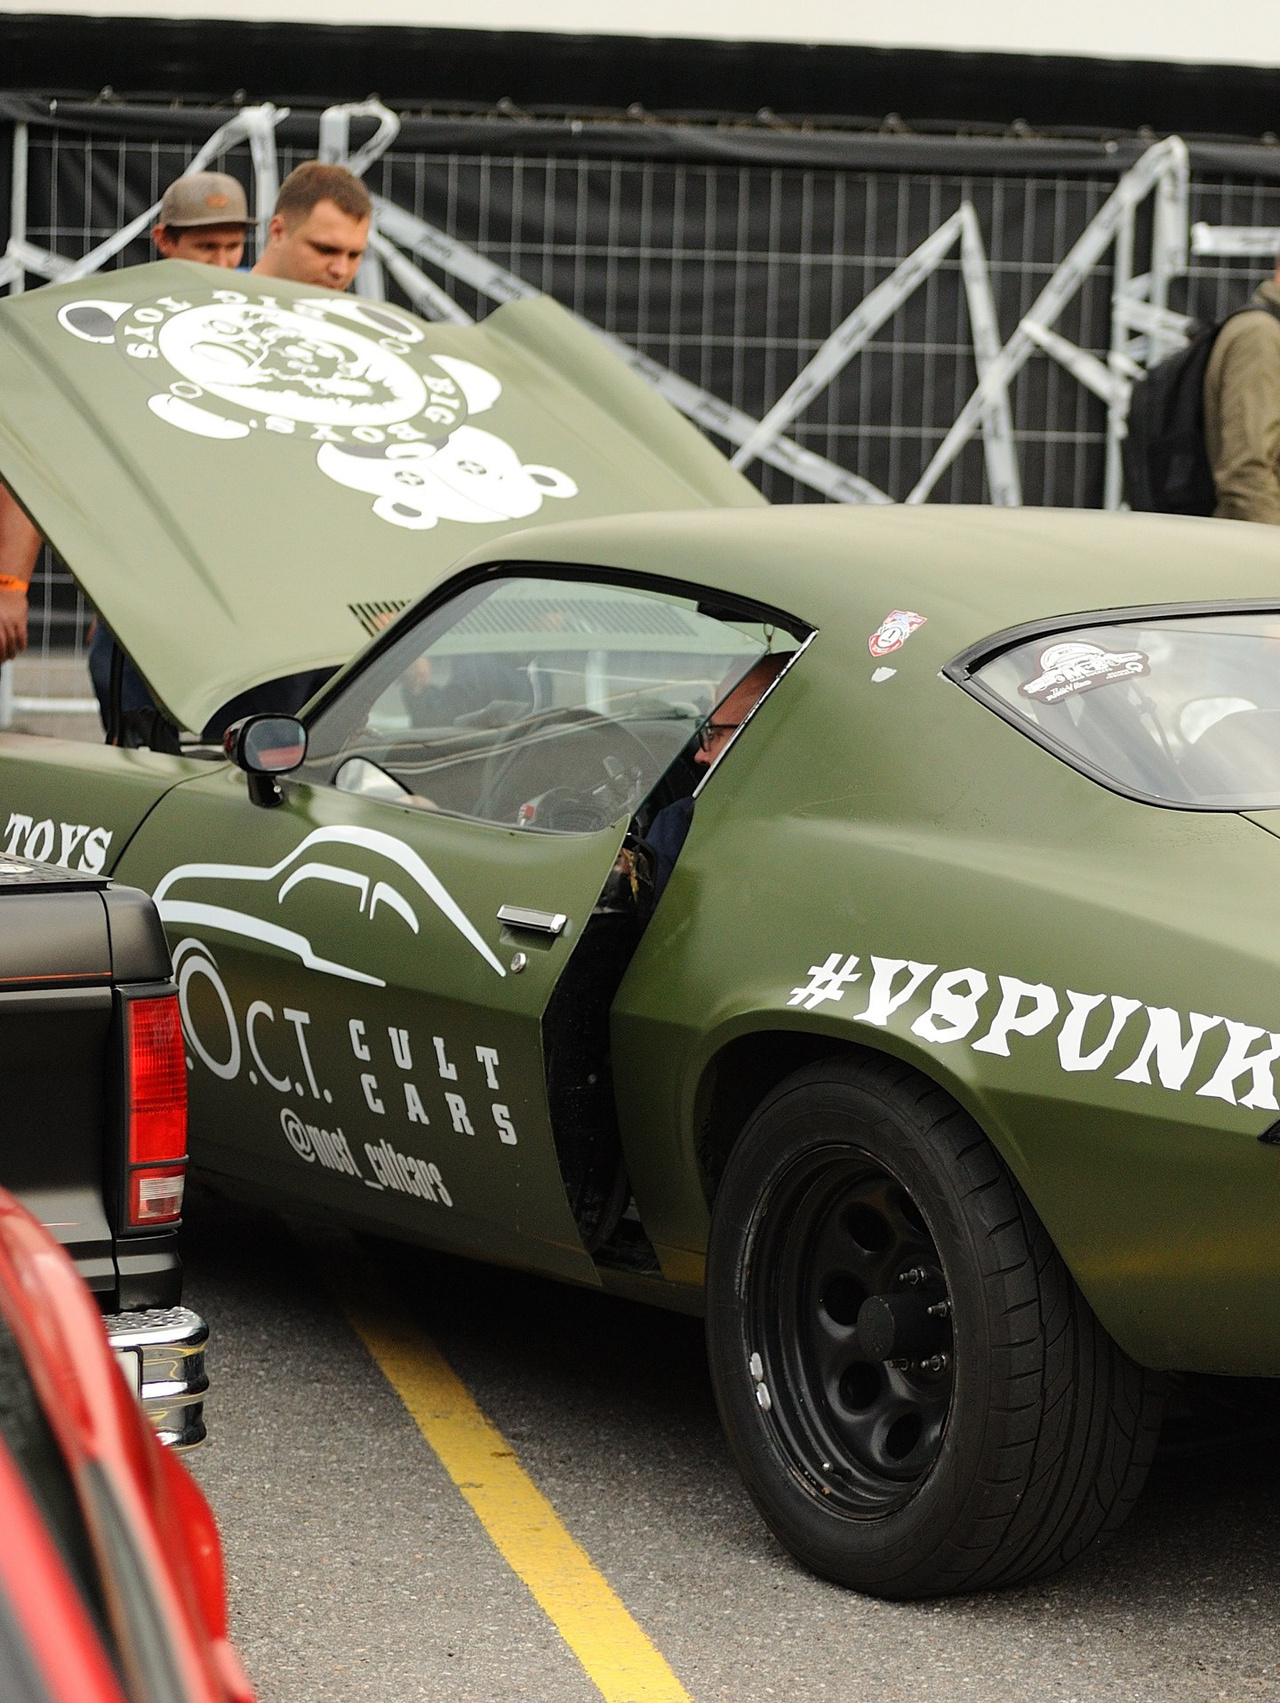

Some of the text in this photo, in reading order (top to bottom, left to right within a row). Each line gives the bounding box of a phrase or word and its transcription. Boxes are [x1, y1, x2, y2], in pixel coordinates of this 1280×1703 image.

[123, 296, 194, 359] TOYS
[422, 373, 460, 425] BIG
[4, 812, 113, 875] TOYS
[348, 1018, 500, 1090] CULT
[360, 1073, 518, 1146] CARS
